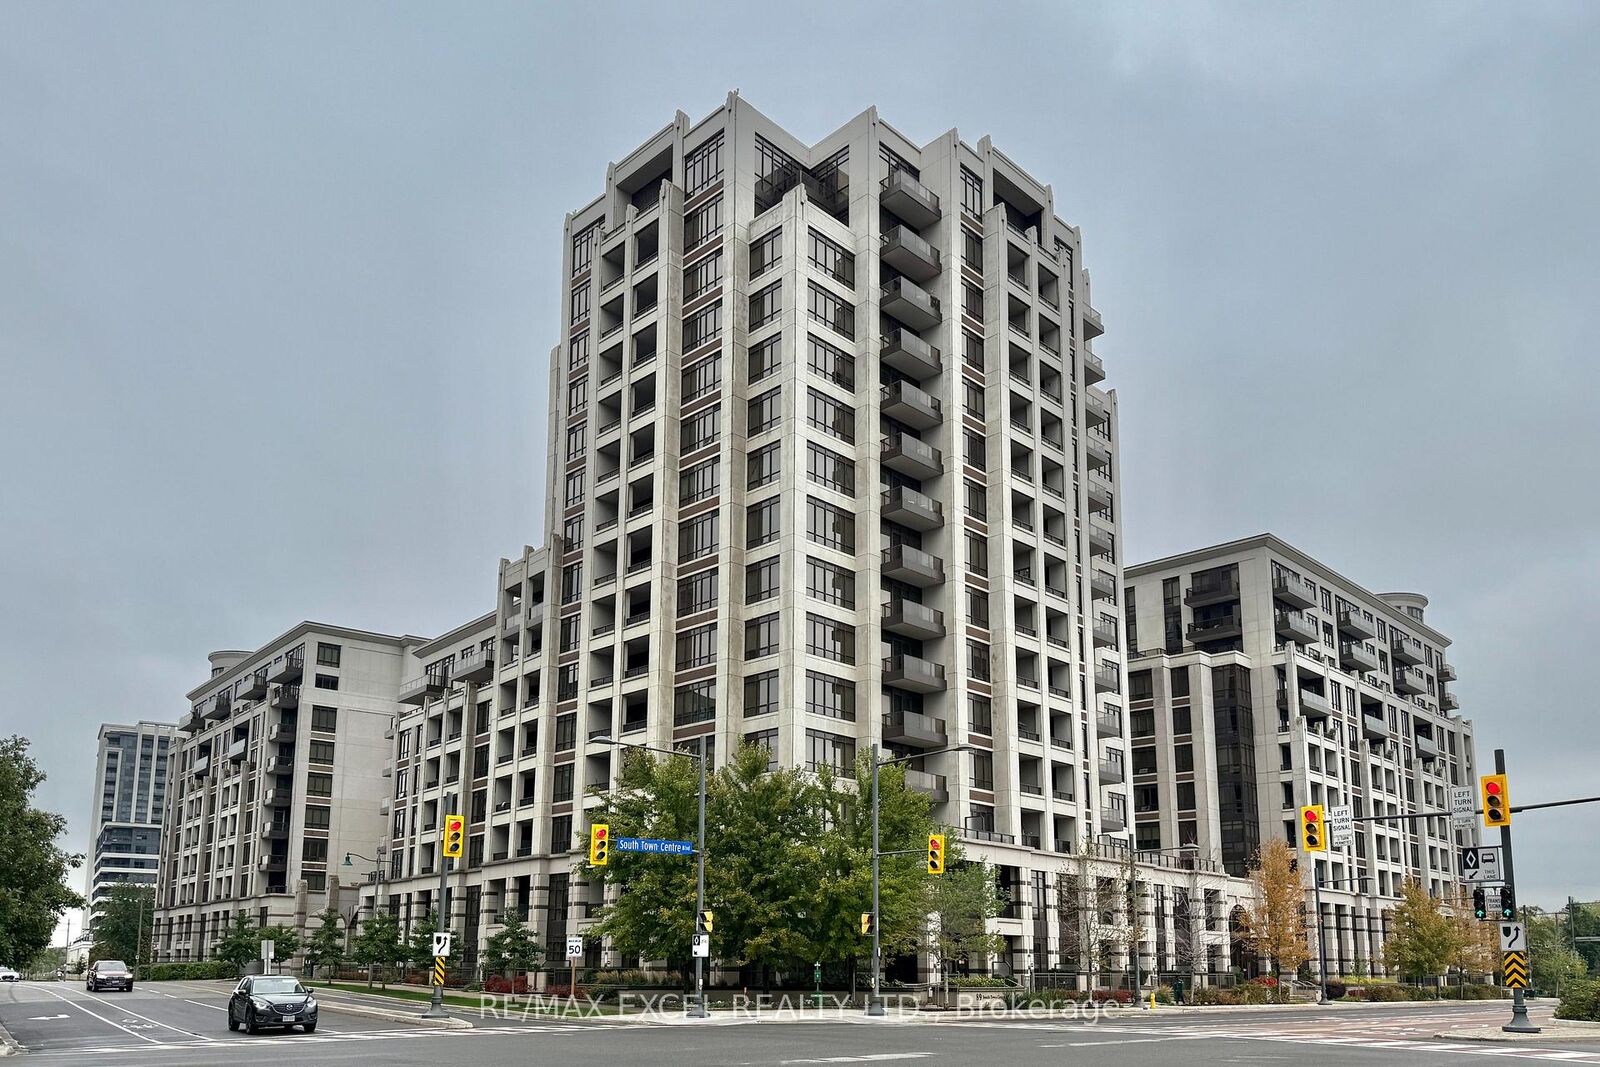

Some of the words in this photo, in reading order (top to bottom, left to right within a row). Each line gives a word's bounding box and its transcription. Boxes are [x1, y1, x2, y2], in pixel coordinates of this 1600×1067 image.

[619, 840, 639, 850] South
[641, 841, 658, 851] Town
[660, 842, 681, 852] Centre
[569, 945, 581, 954] 50
